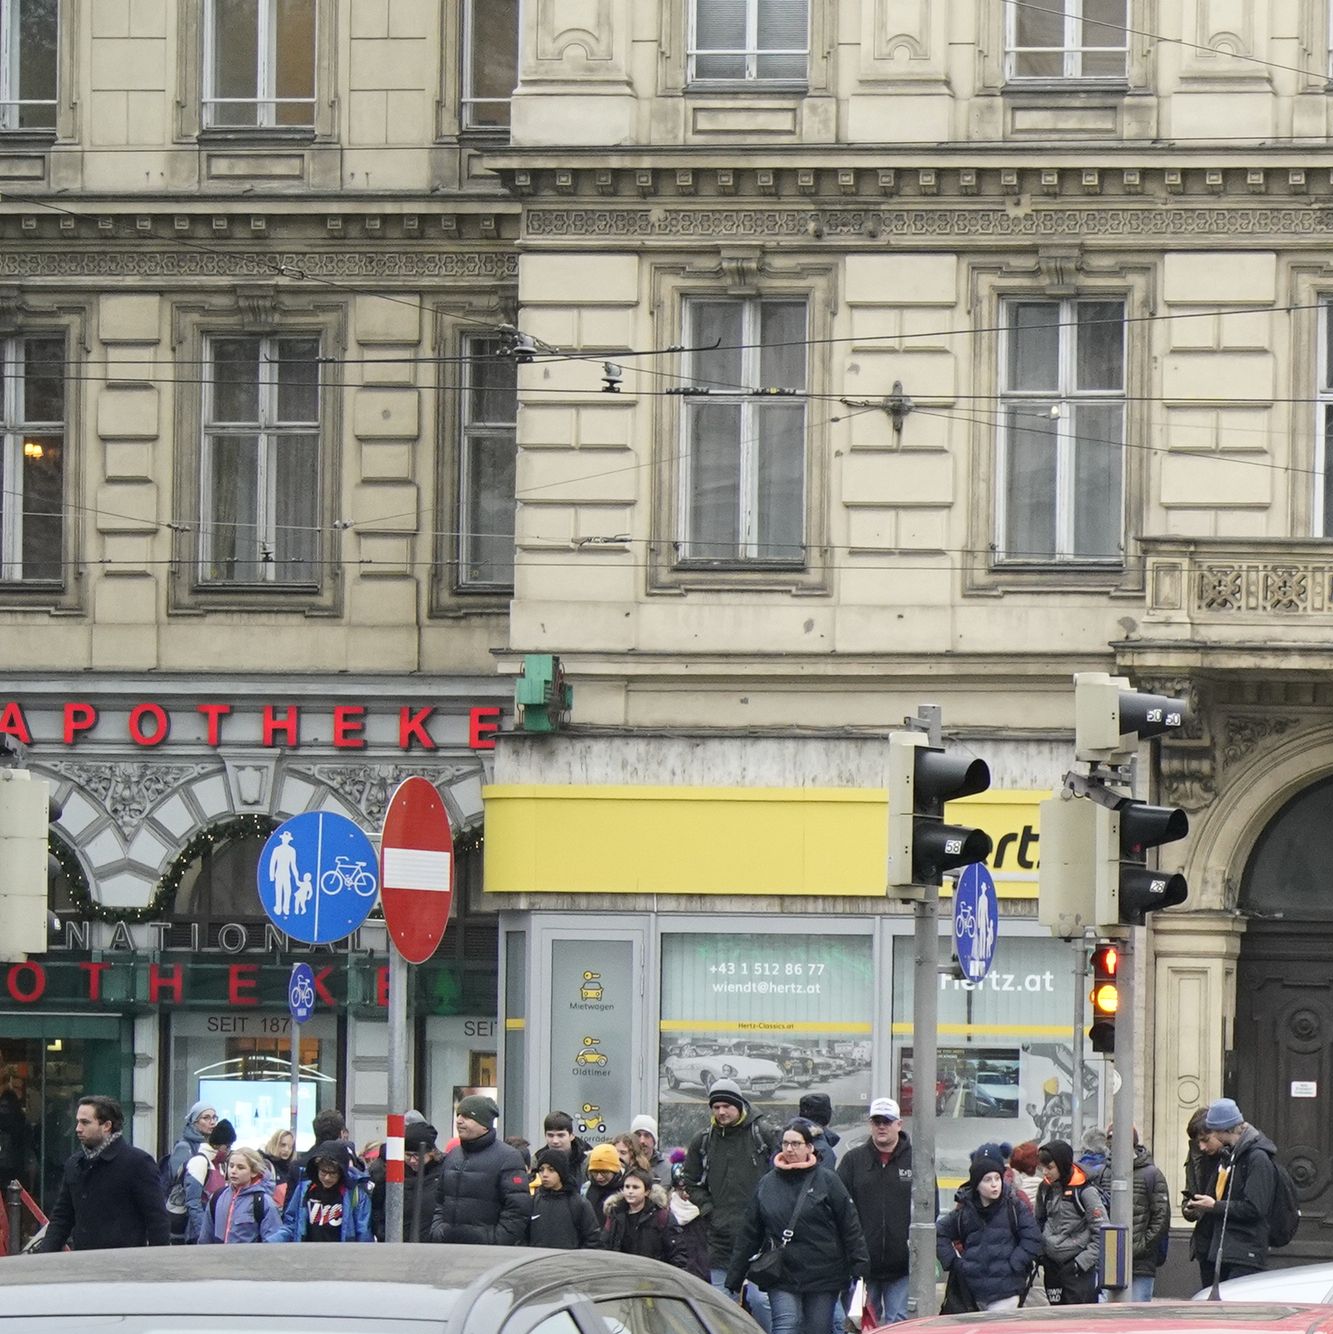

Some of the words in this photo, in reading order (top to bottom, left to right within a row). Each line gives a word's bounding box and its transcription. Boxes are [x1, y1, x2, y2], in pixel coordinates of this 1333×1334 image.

[0, 702, 500, 749] APOTHEKE
[945, 840, 961, 853] 58
[709, 963, 736, 975] +43
[741, 963, 749, 975] 1
[754, 963, 780, 975] 512
[785, 963, 802, 975] 86
[808, 963, 825, 975] 77
[712, 981, 821, 994] wiendt@hertz.at
[569, 1002, 615, 1011] Mietwagen
[207, 1016, 248, 1033] SEIT
[260, 1016, 291, 1034] 187
[464, 1020, 498, 1037] SEI
[572, 1068, 611, 1077] Oldtimer
